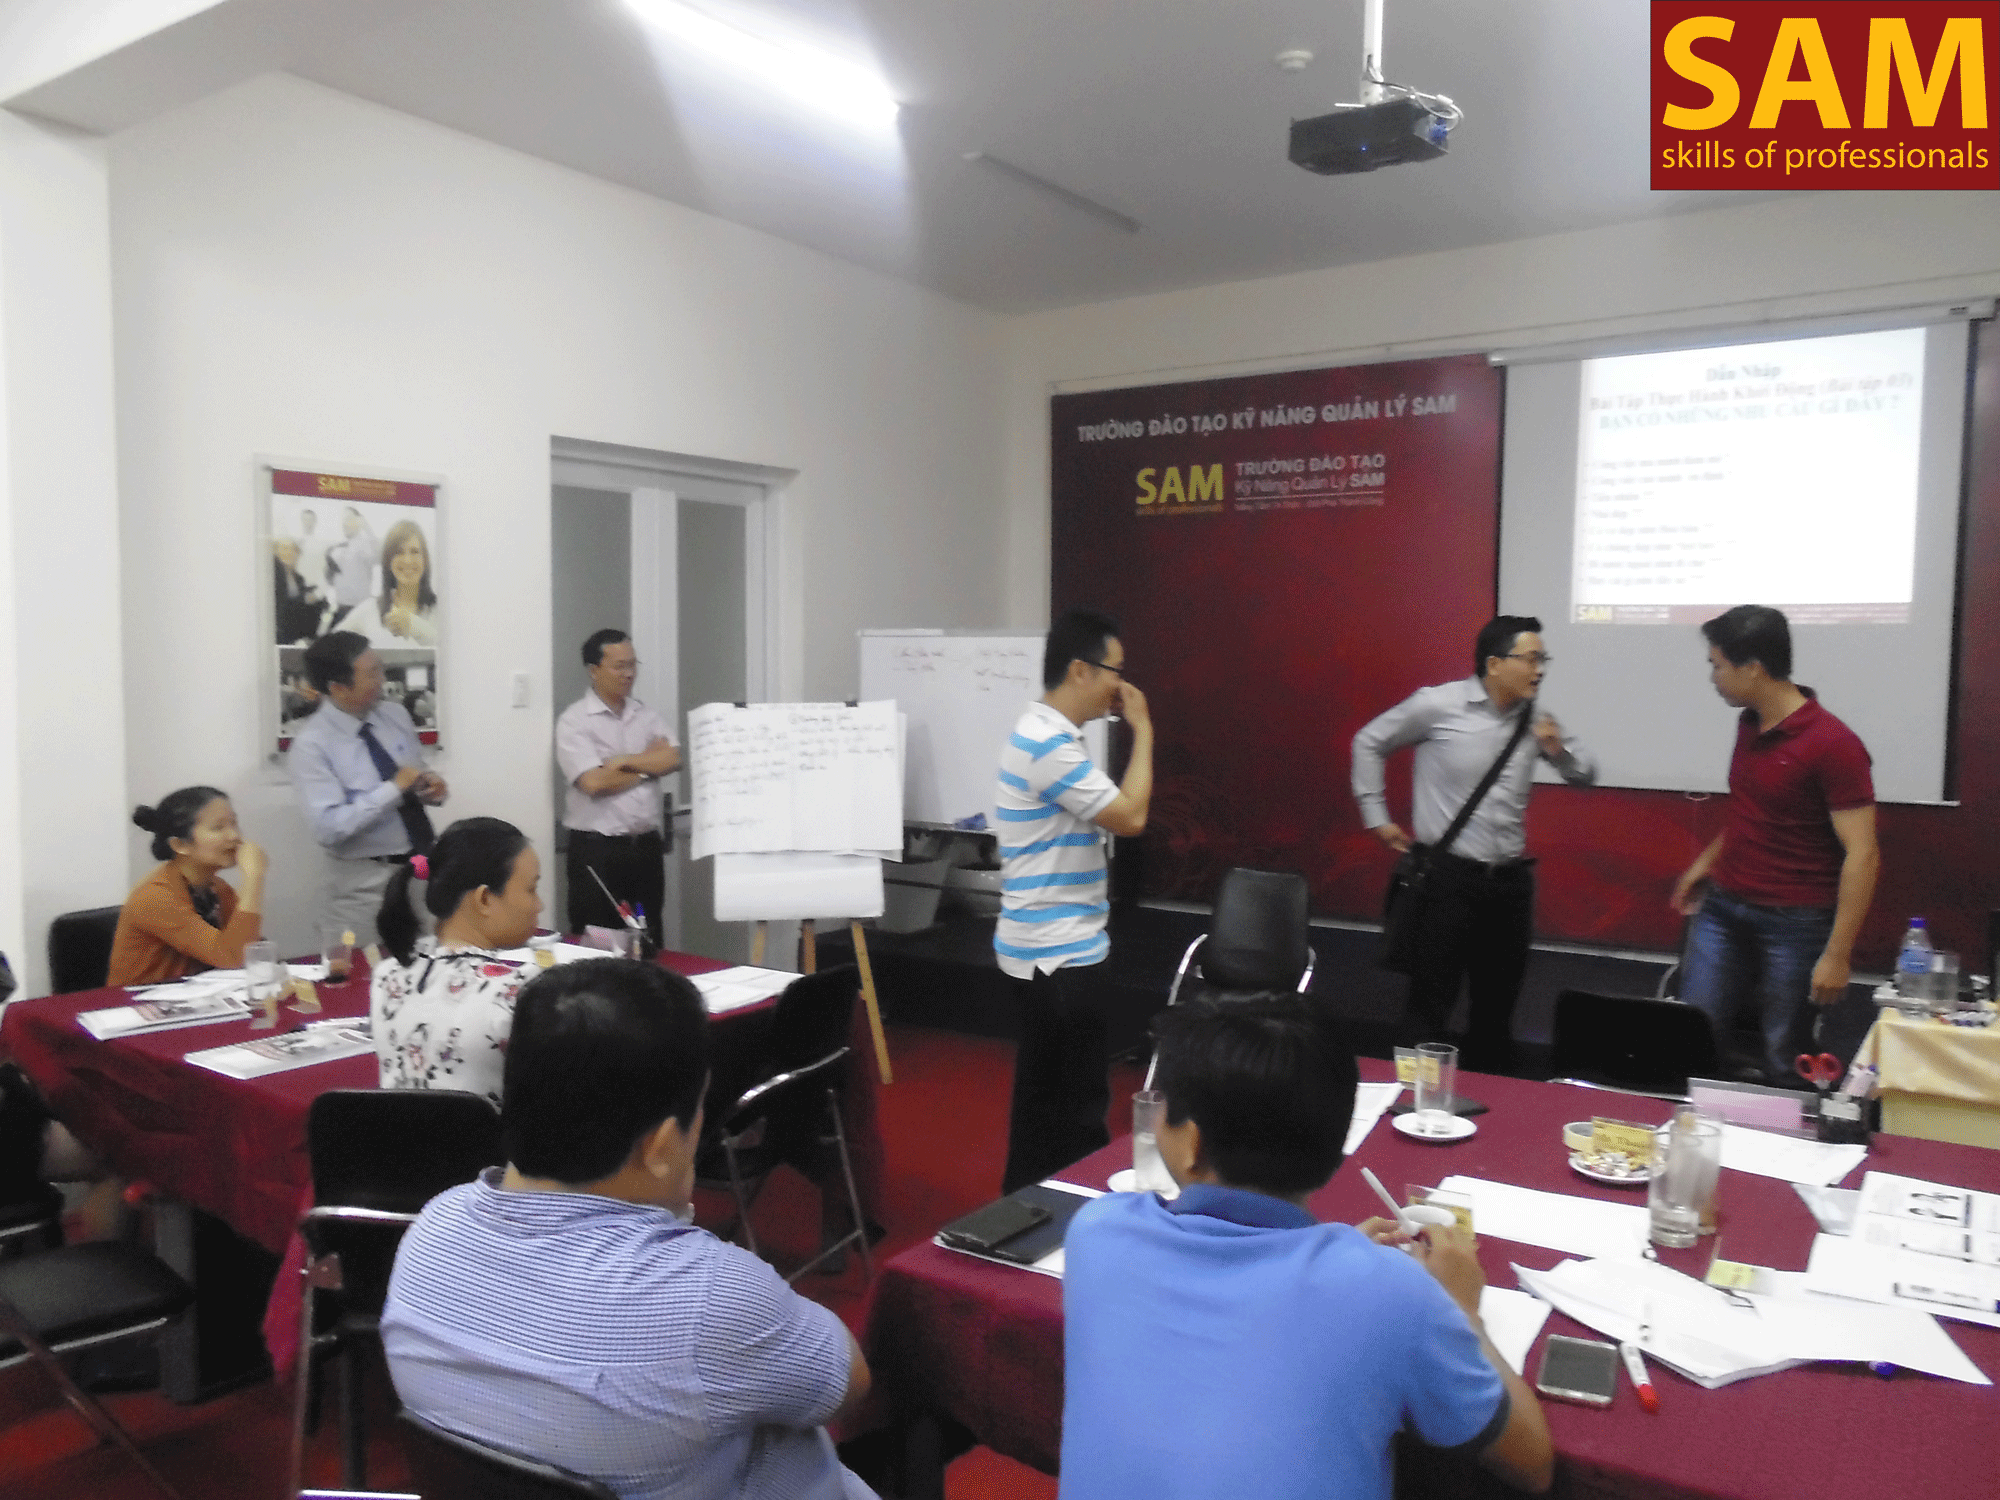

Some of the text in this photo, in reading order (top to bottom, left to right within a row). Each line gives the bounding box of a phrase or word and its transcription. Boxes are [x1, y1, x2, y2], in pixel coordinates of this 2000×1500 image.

[1077, 393, 1457, 442] TRƯỜNG ĐÀO TẠO KỸ NĂNG QUẢN LÝ SAM
[1135, 463, 1224, 505] SAM
[1348, 472, 1386, 488] SAM
